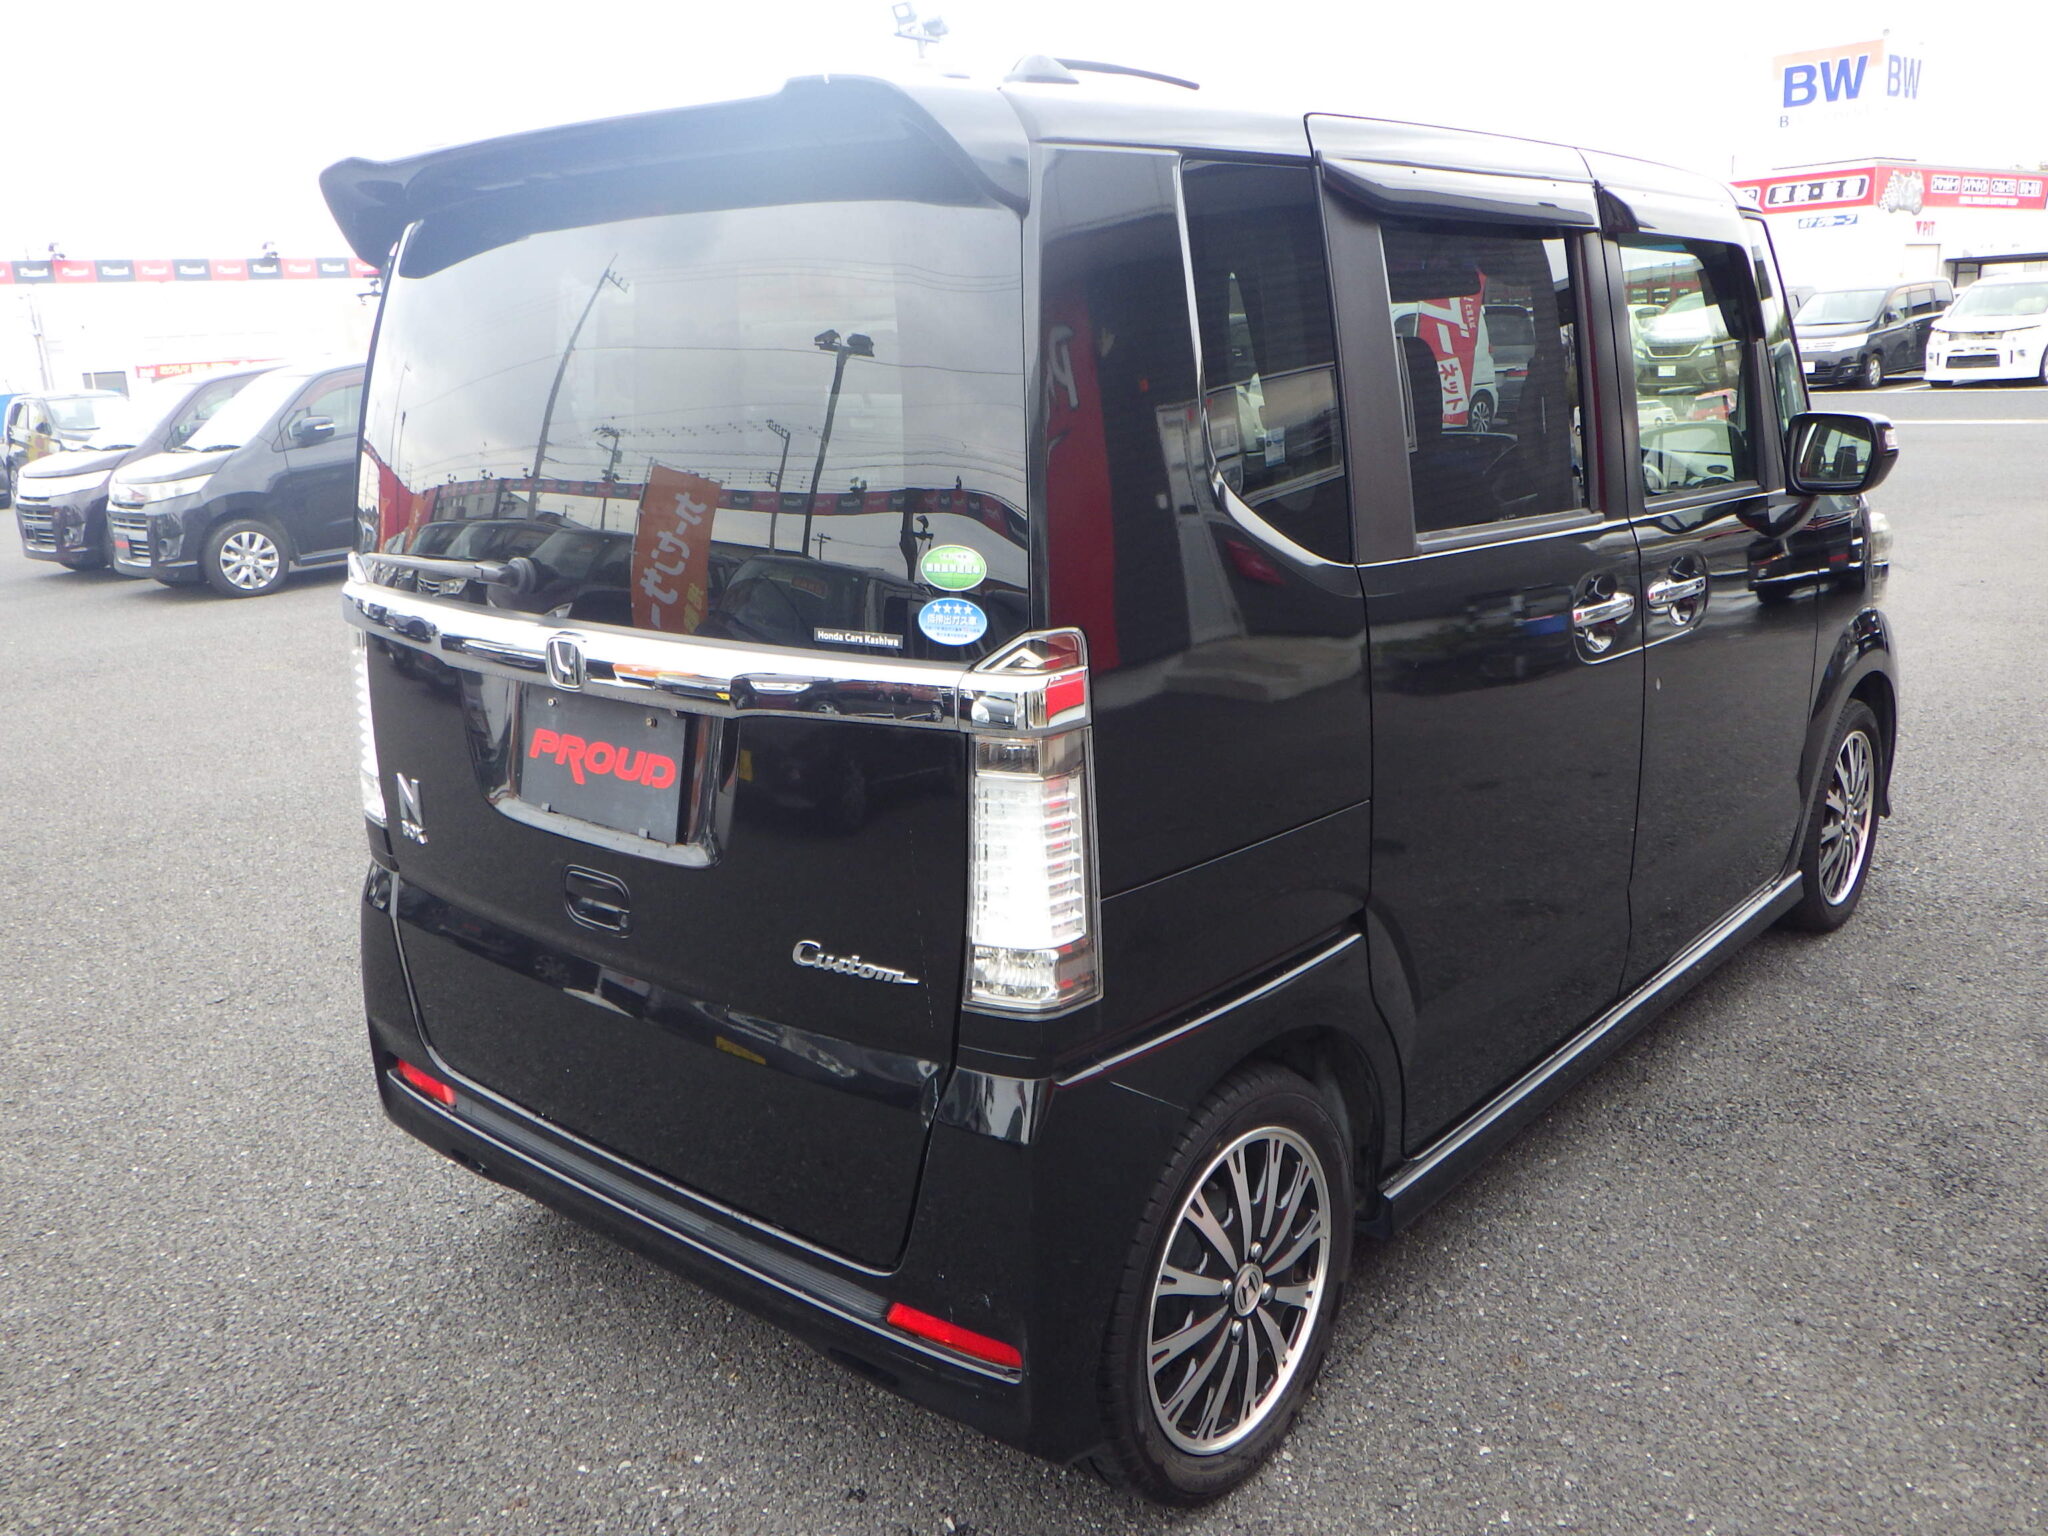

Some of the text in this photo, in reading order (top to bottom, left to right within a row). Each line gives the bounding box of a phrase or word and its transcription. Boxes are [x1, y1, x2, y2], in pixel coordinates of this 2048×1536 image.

[1783, 55, 1868, 108] BW
[1887, 54, 1922, 99] BW
[817, 630, 899, 646] Honda Cars Kashiwa
[528, 727, 677, 789] PROUD
[792, 940, 919, 984] Custom
